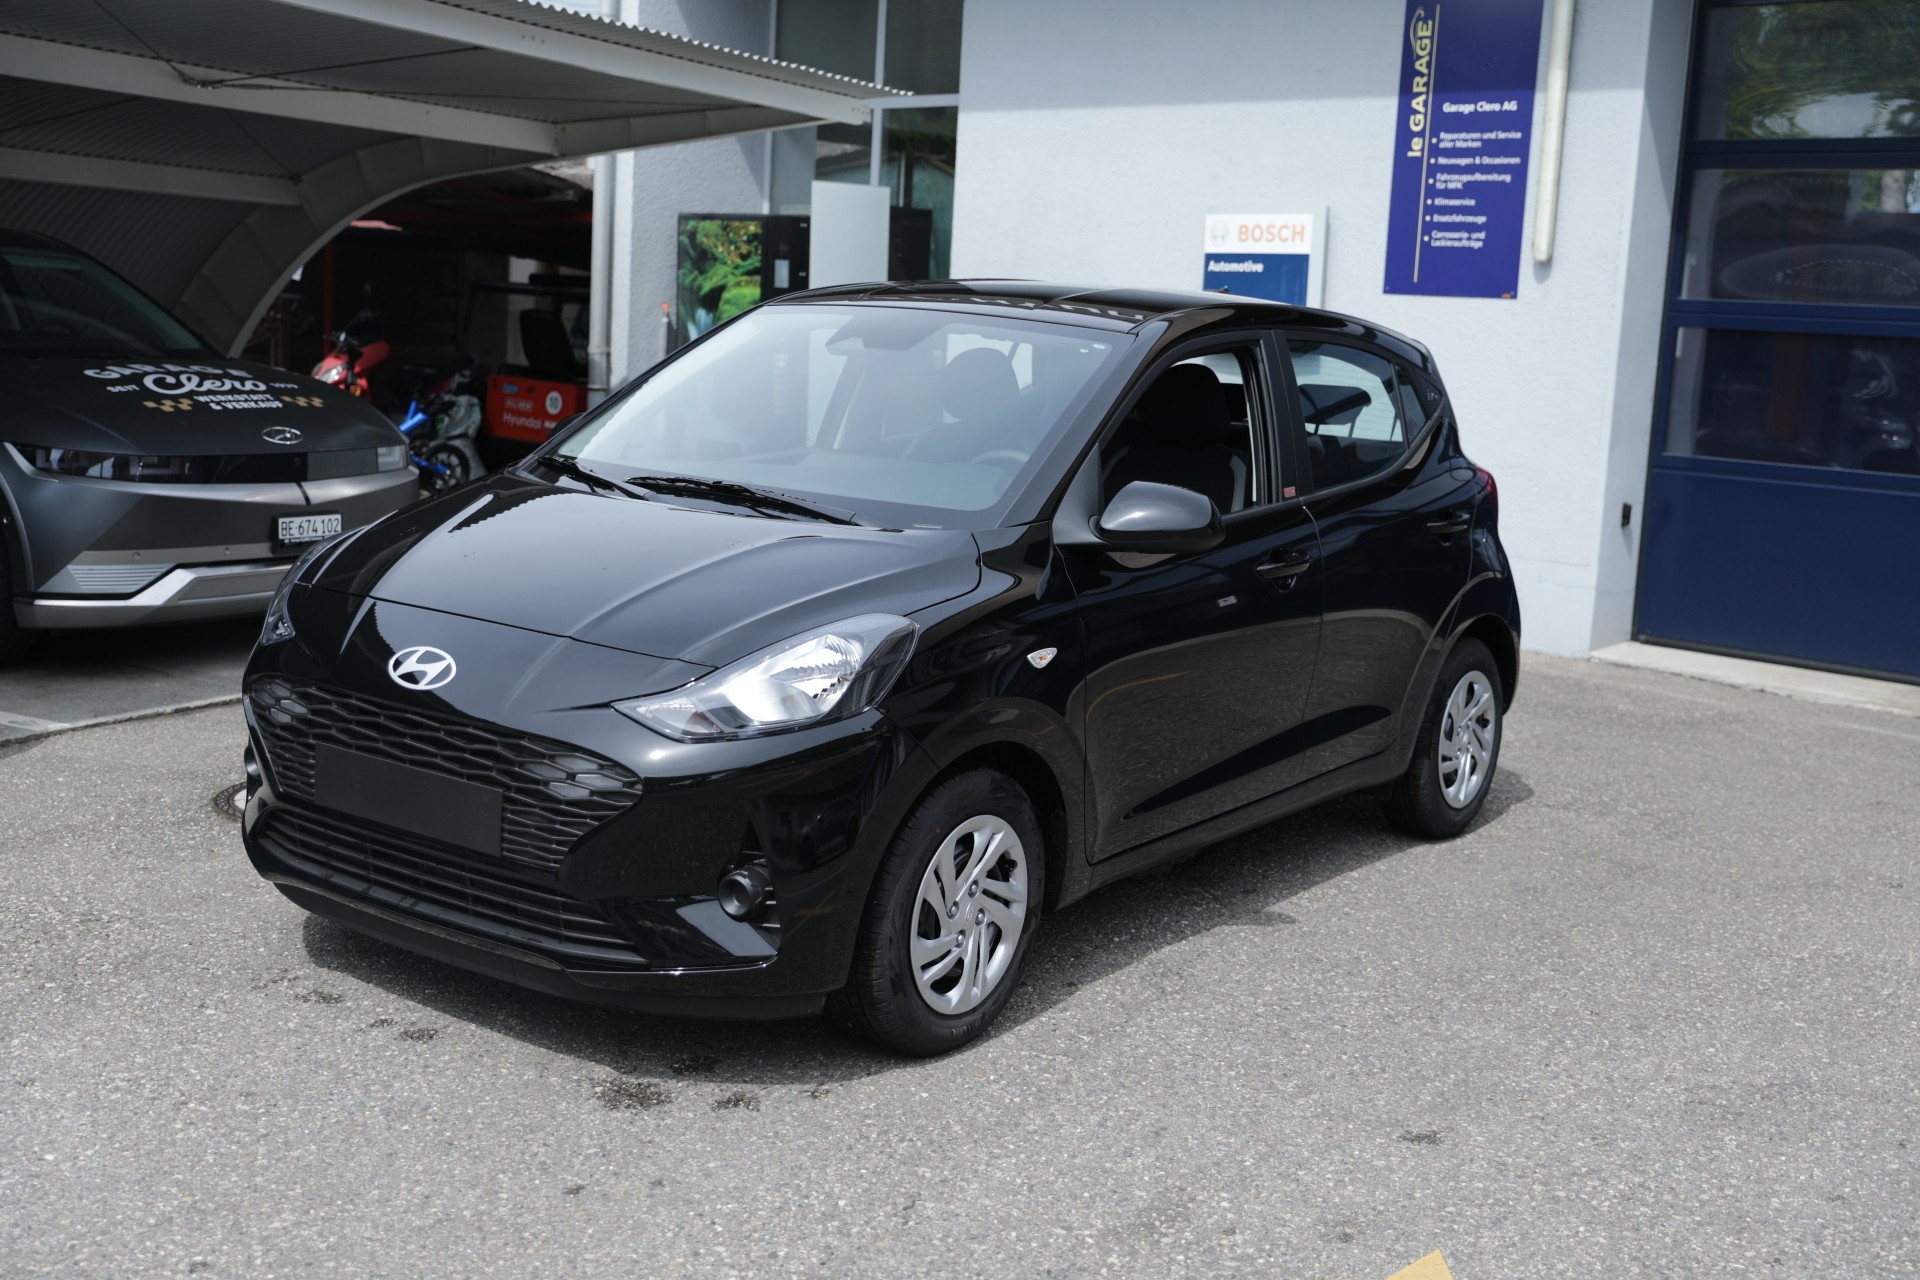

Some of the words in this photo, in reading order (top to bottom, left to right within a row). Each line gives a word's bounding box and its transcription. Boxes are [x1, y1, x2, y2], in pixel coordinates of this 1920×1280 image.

[1409, 19, 1433, 132] GARAGE
[1443, 102, 1475, 114] Garage
[1476, 101, 1501, 112] Clero
[1502, 101, 1517, 111] AG
[1440, 131, 1481, 141] Reparaturen
[1482, 131, 1496, 139] und
[1497, 130, 1522, 139] Service
[1407, 137, 1423, 157] le
[1455, 140, 1482, 148] Marken
[1438, 156, 1474, 166] Neuwagen
[1481, 156, 1521, 165] Occasionen
[1434, 197, 1476, 206] Klimaservice
[1433, 214, 1487, 224] Ersatzfahrzeuge
[1238, 223, 1305, 243] BOSCH
[1471, 231, 1485, 239] und
[1207, 260, 1264, 273] Automotive
[83, 363, 253, 379] GARAGE
[106, 384, 140, 393] SEIT
[143, 373, 267, 394] Clero
[193, 394, 275, 403] WERKSTATT
[209, 402, 223, 410] &
[226, 401, 284, 410] VERKAUF
